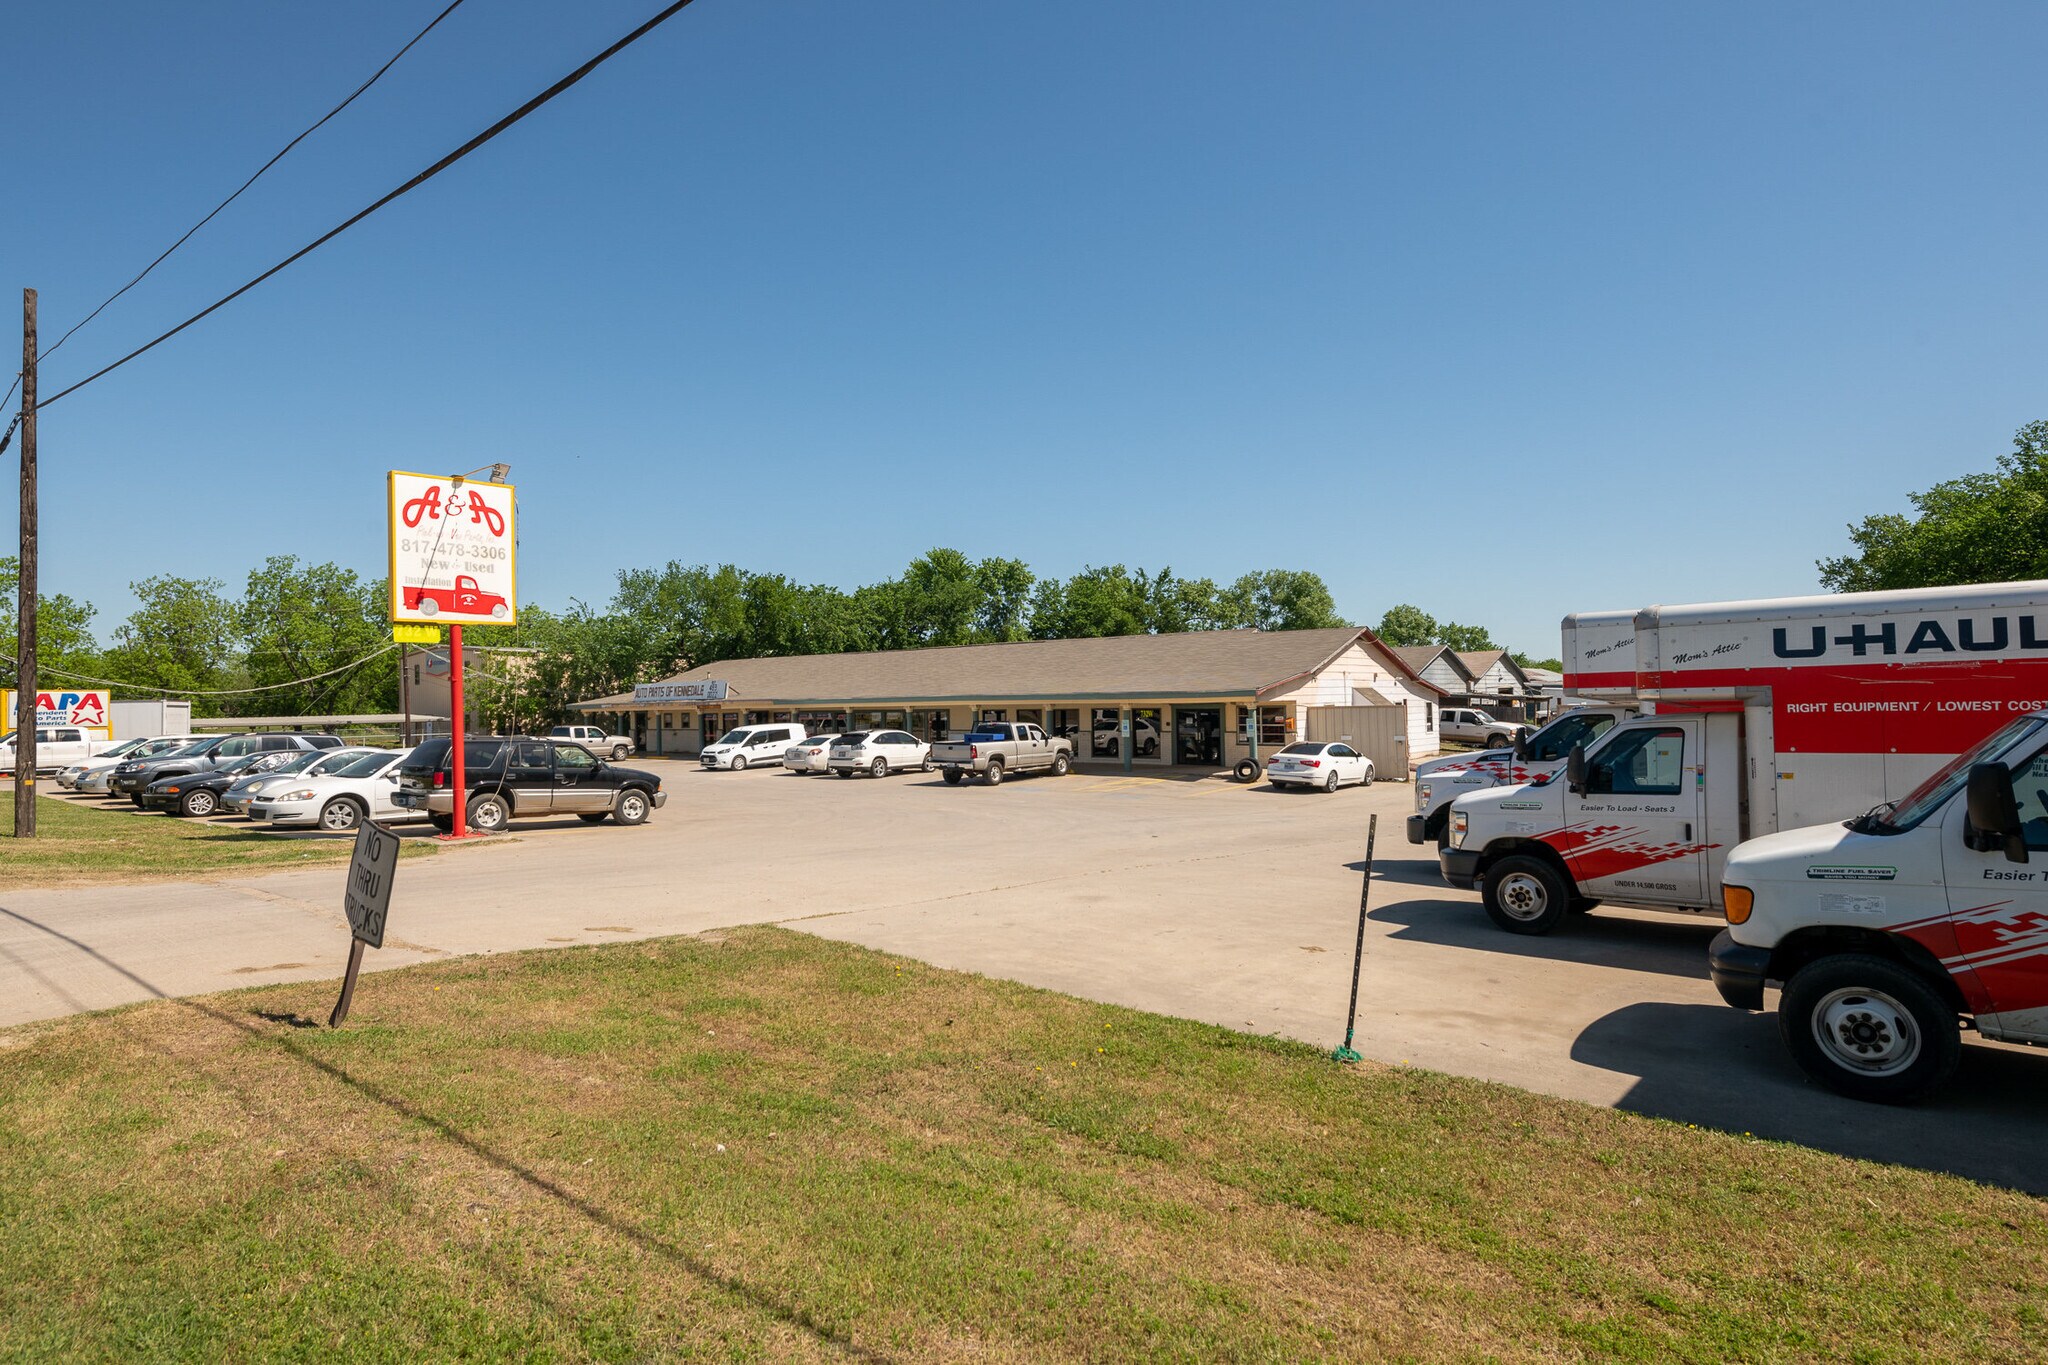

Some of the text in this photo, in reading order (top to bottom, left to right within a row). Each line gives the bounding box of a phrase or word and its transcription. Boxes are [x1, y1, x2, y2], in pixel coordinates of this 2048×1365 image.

[401, 538, 506, 560] 817-478-3306
[421, 558, 449, 570] New
[464, 561, 495, 574] Used
[404, 576, 452, 587] Installation
[1773, 615, 2048, 659] U-HAUL
[1585, 638, 1635, 659] Mom's Attic
[1672, 642, 1742, 664] Mom's Attic
[635, 688, 648, 699] AUTO
[648, 686, 665, 698] PARTS
[665, 686, 673, 697] OF
[674, 685, 704, 696] KENNEDALE
[1786, 702, 1827, 714] RIGHT
[1833, 701, 1919, 713] EQUIPMENT
[1937, 700, 2002, 712] LOWEST
[364, 831, 382, 863] NO
[354, 862, 381, 899] THRU
[1614, 880, 1636, 888] UNDER
[1655, 883, 1677, 891] GROSS
[1983, 869, 2036, 882] Easier
[346, 892, 382, 937] TRUCKS
